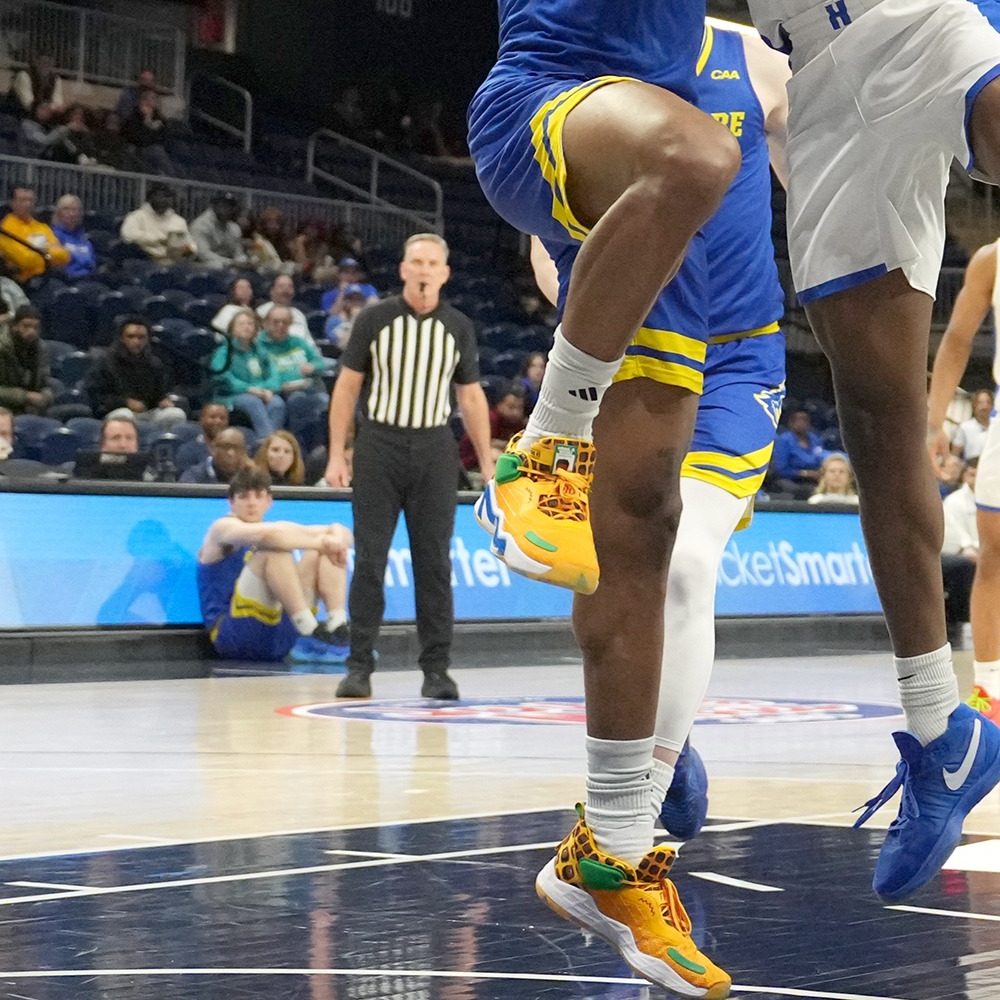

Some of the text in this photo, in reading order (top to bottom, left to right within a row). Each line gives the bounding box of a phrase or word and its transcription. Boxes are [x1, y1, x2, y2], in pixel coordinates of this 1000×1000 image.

[825, 0, 852, 30] H
[710, 69, 741, 80] CAA
[718, 540, 874, 587] cketSmart
